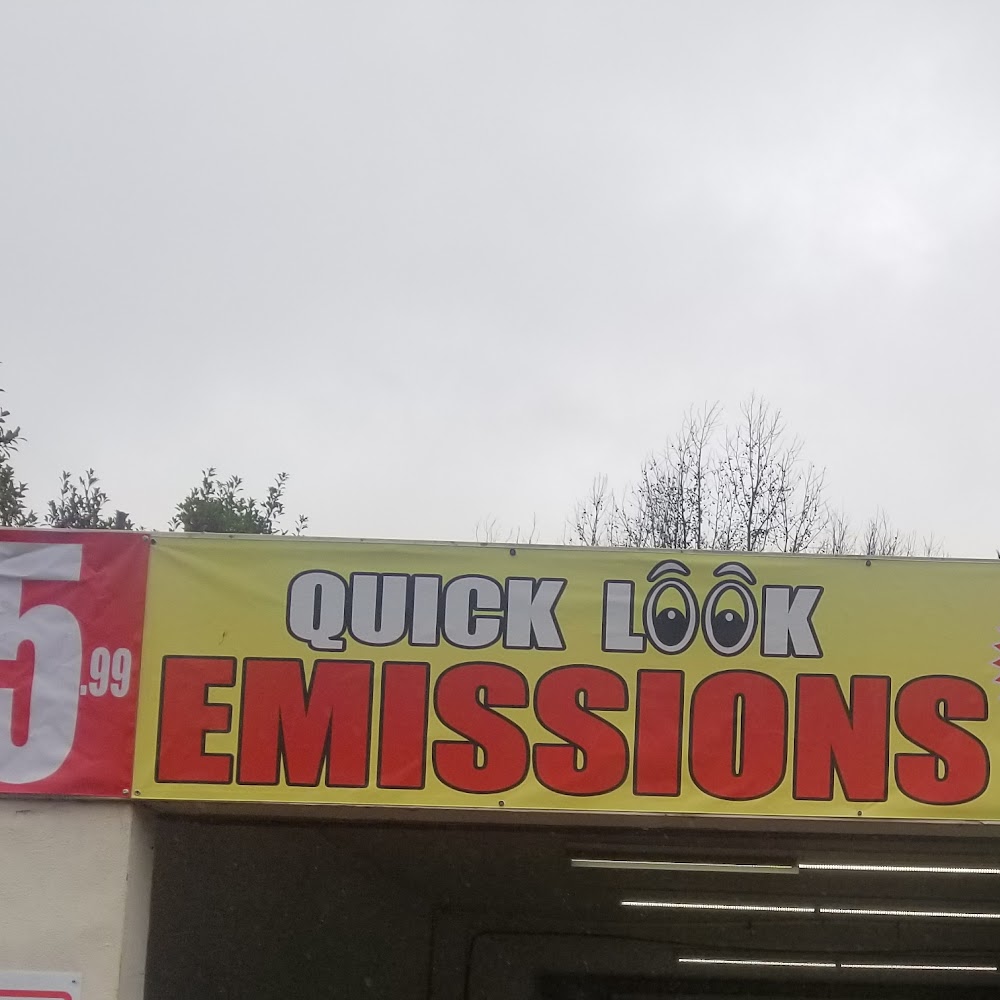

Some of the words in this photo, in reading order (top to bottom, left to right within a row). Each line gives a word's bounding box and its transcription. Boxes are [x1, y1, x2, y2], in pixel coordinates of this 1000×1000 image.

[286, 569, 567, 652] QUICK
[602, 560, 824, 658] LOOK
[154, 655, 991, 805] EMISSIONS
